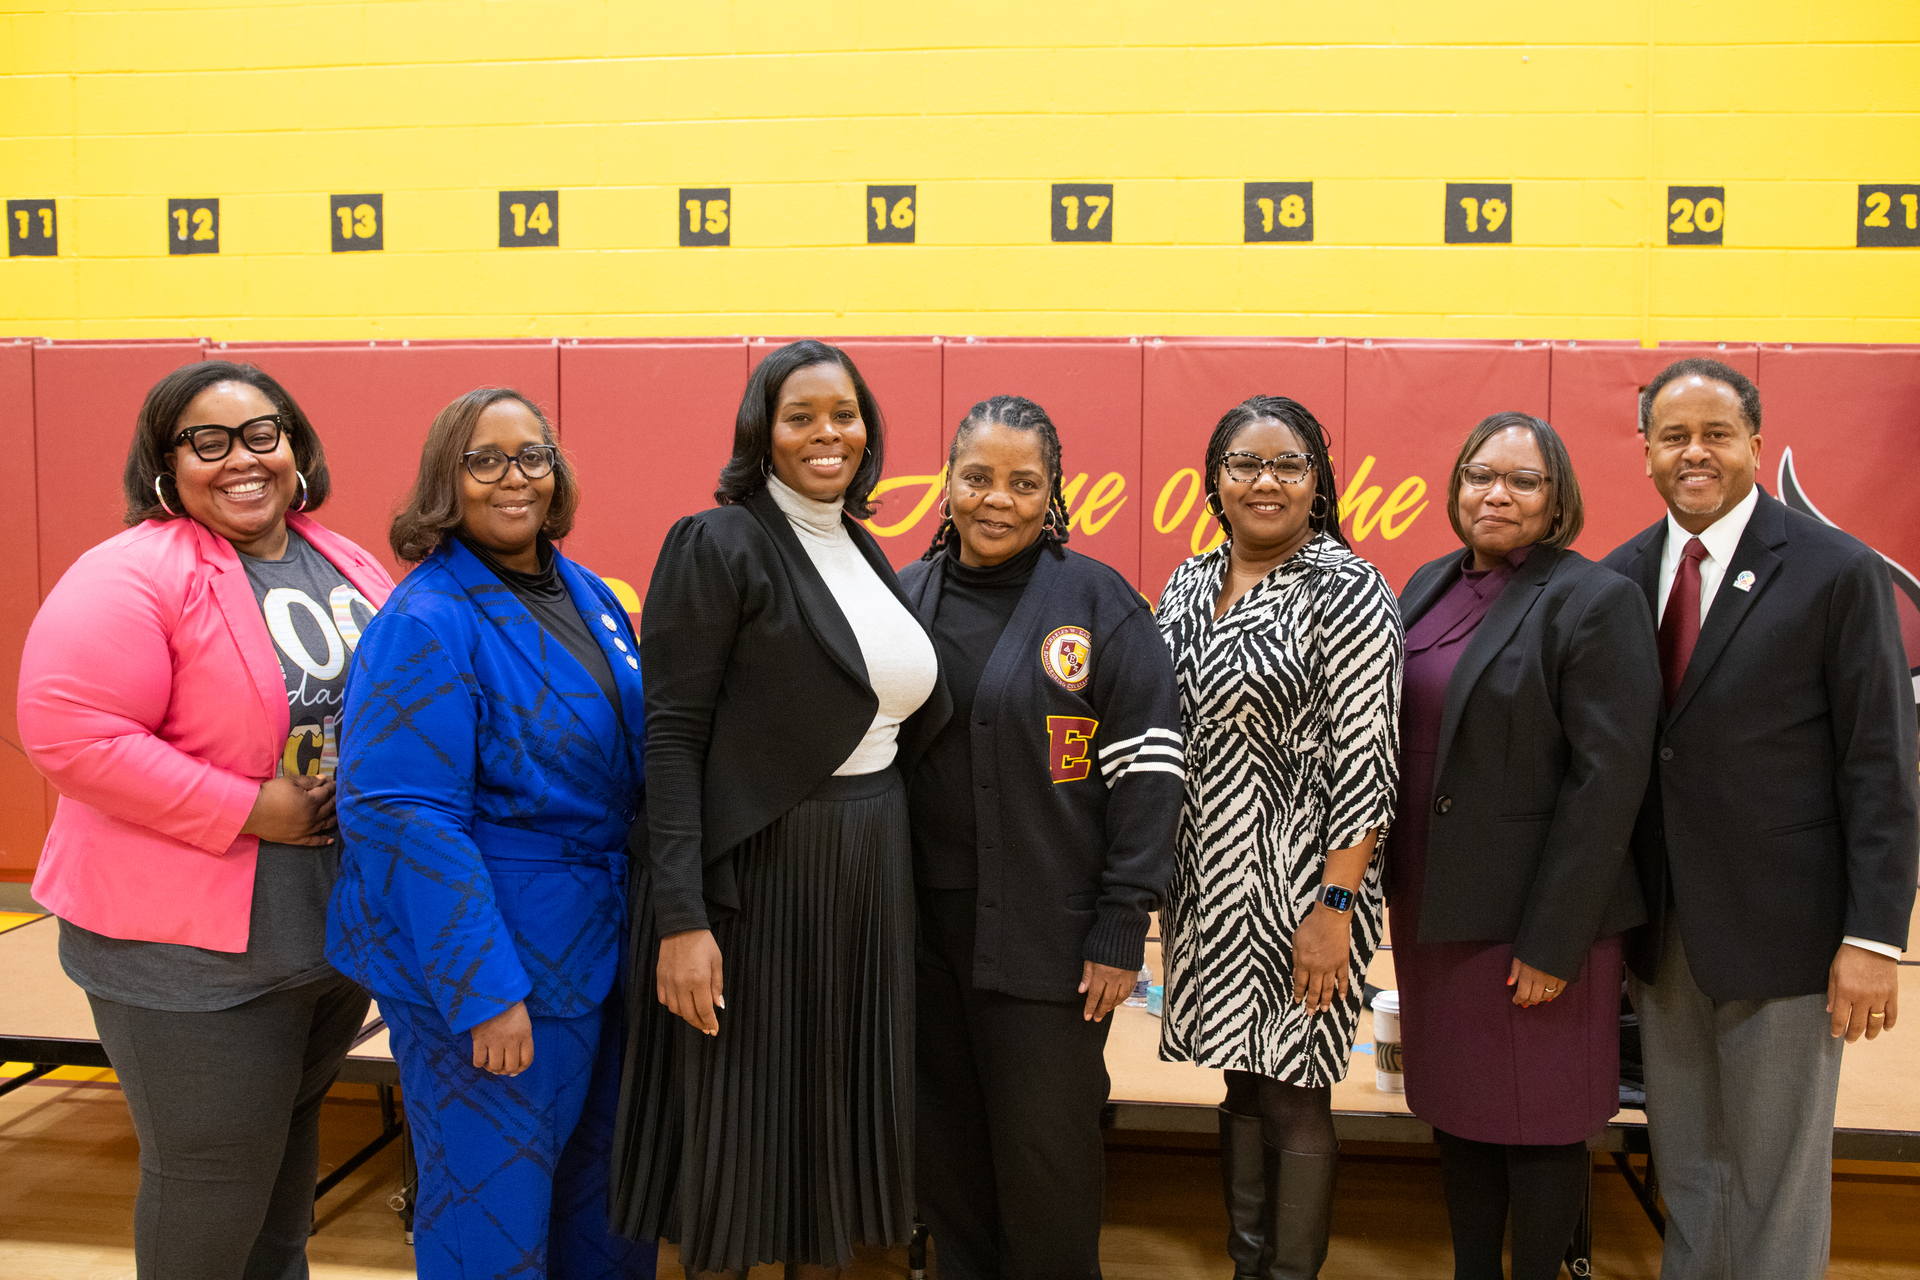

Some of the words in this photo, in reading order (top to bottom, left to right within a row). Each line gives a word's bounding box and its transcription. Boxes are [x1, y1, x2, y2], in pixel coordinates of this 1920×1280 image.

[15, 208, 53, 239] 11
[173, 207, 216, 241] 12
[337, 203, 378, 240] 13
[510, 202, 553, 236] 14
[686, 199, 729, 235] 15
[871, 196, 915, 231] 16
[1060, 195, 1110, 230] 17
[1255, 194, 1307, 233] 18
[1459, 197, 1508, 233] 19
[1669, 197, 1724, 233] 20
[1864, 191, 1919, 229] 21
[1328, 455, 1430, 543] he
[263, 584, 379, 681] 00
[1046, 715, 1100, 785] E
